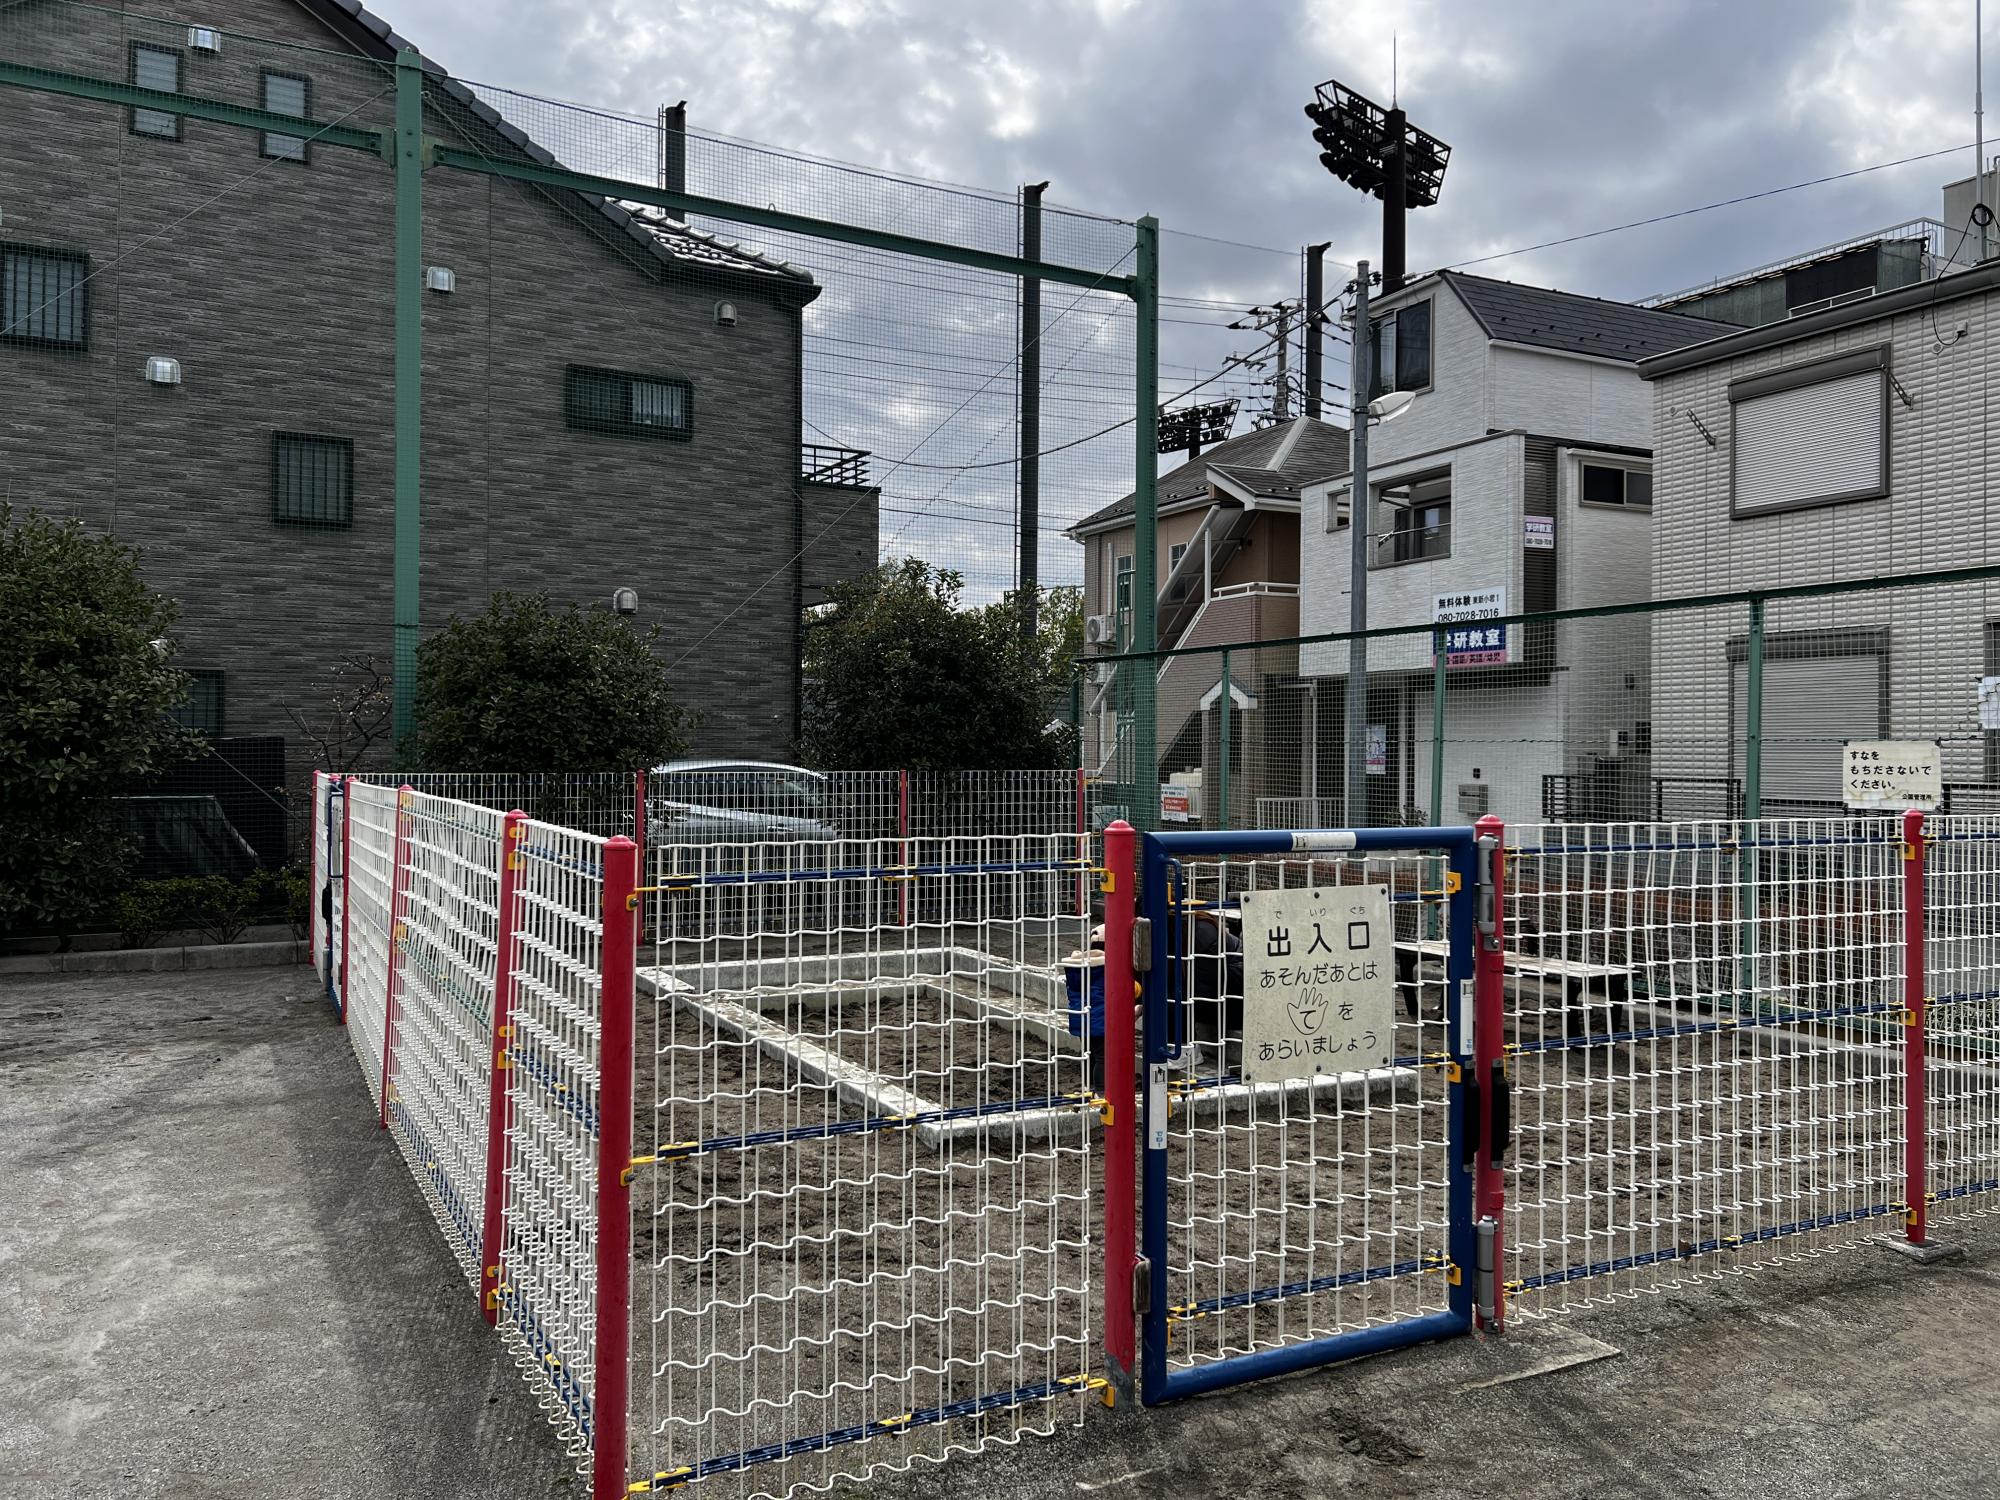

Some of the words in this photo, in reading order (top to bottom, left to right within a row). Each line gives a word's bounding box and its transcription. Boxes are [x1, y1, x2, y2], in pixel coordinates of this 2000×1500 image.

[1439, 595, 1470, 609] 無料体験
[1850, 751, 1879, 760] すなを
[1850, 765, 1932, 775] もちださないで
[1850, 779, 1896, 789] ください。
[1267, 921, 1370, 957] 出入口
[1260, 960, 1378, 988] あそんだあとは
[1258, 1031, 1377, 1061] あらいましょう
